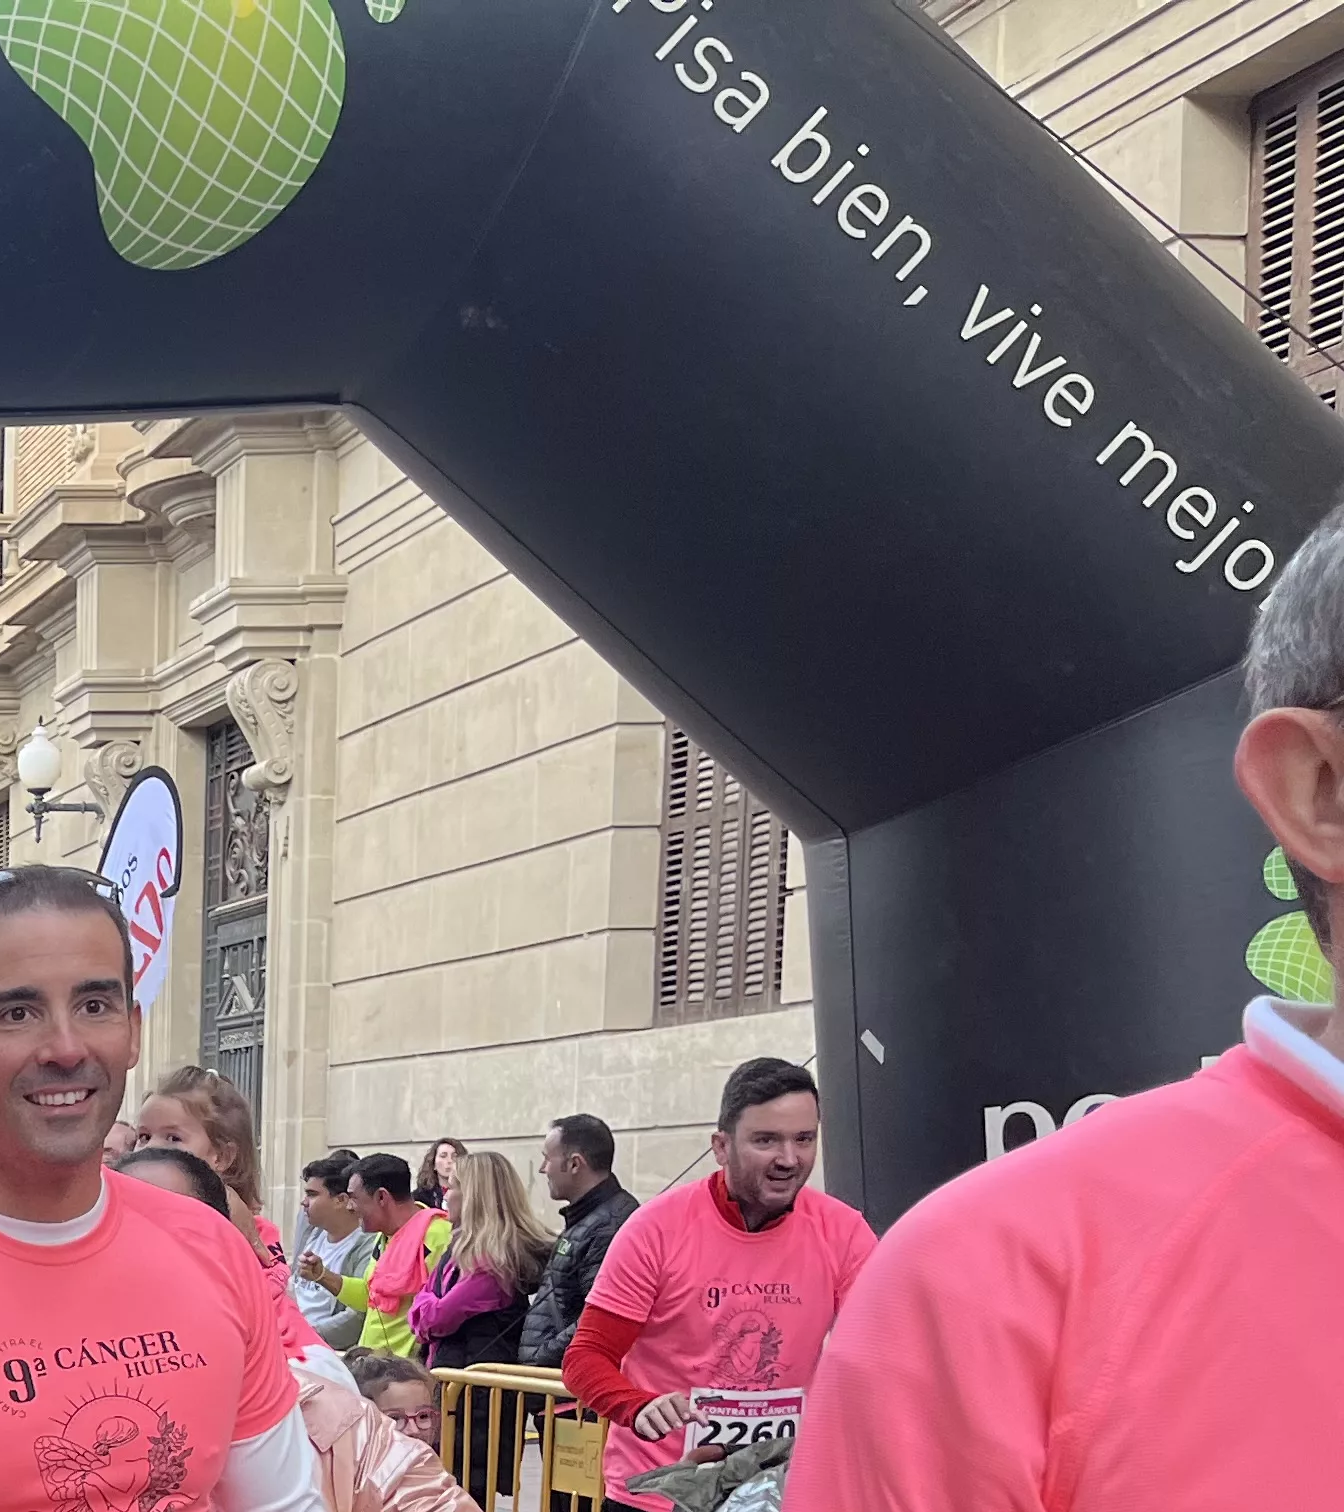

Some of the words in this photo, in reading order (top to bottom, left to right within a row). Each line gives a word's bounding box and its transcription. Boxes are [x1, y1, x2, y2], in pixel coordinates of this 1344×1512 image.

[770, 106, 933, 307] bien,
[959, 283, 1097, 428] vive
[1095, 421, 1278, 611] mejo
[731, 1281, 792, 1296] CÁNCER
[54, 1330, 182, 1370] CÁNCER
[124, 1353, 208, 1379] HUESCA
[702, 1406, 746, 1417] CONTRA
[747, 1407, 759, 1417] EL
